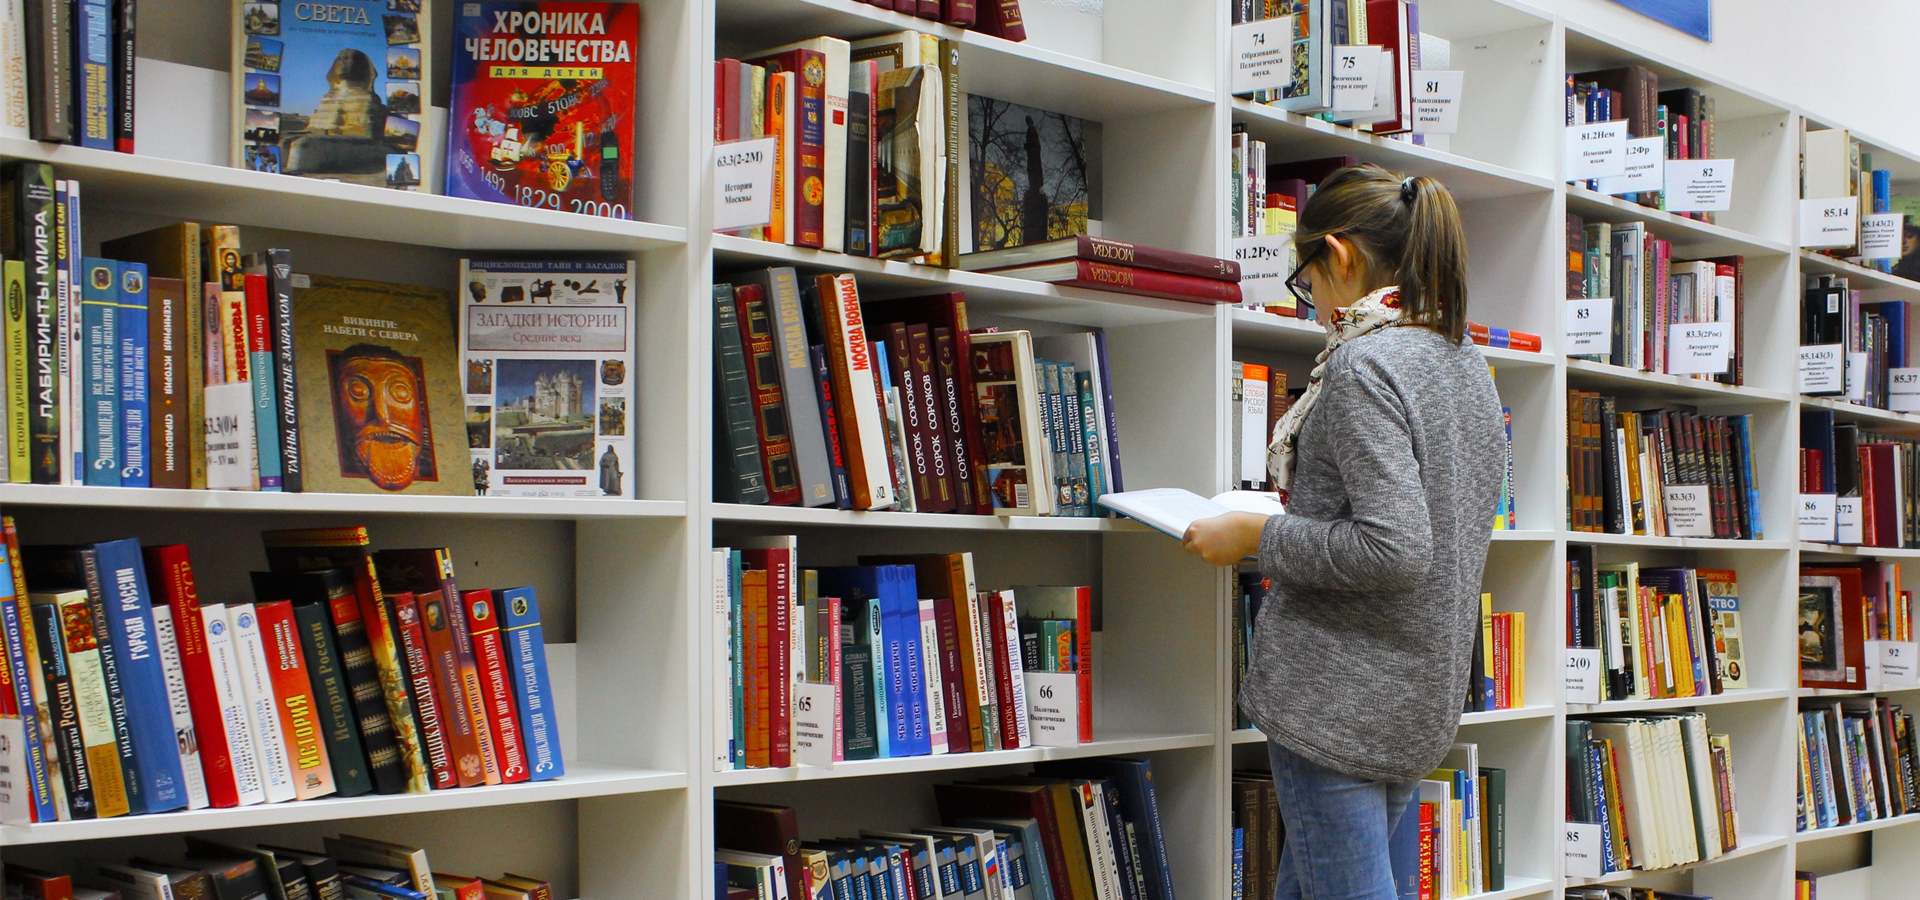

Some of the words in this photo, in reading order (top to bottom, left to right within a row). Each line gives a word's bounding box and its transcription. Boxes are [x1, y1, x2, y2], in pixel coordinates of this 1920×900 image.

[294, 3, 371, 26] СВЕТА
[492, 11, 605, 35] ХРОНИКА
[464, 38, 631, 63] ЧЕЛОВЕЧЕСТВА
[1252, 32, 1265, 46] 74
[544, 69, 598, 77] ДЕТЕЙ
[1342, 56, 1356, 70] 75
[1426, 80, 1439, 93] 81
[1626, 146, 1650, 156] 1.2Фр
[1702, 168, 1714, 178] 82
[515, 184, 560, 214] 1829
[724, 182, 752, 192] История
[724, 194, 752, 204] Москвы
[57, 202, 66, 224] САМ!
[1824, 208, 1849, 218] 85.14
[35, 210, 50, 275] МИРА
[58, 227, 67, 260] СДЕЛАЙ
[1092, 242, 1134, 262] МОСКВА
[1235, 245, 1279, 260] 81.2Рус
[838, 278, 860, 326] ВОЕННАЯ
[1577, 308, 1590, 319] 83
[164, 298, 173, 350] ВСЕМИРНАЯ
[279, 293, 292, 362] ЗАБРАЛОМ
[477, 312, 543, 328] ЗАГАДКИ
[546, 313, 618, 328] ИСТОРИИ
[324, 324, 367, 338] НАБЕГИ
[378, 330, 418, 342] СЕВЕРА
[513, 331, 558, 346] Средние
[560, 334, 582, 344] века
[37, 282, 53, 419] ЛАБИРИНТЫ
[848, 327, 868, 371] МОСКВА
[164, 355, 173, 394] ИСТОРИЯ
[1894, 374, 1918, 384] 85.37
[282, 365, 296, 424] СКРЫТЫЕ
[903, 370, 918, 427] СОРОКОВ
[922, 374, 938, 430] СОРОКОВ
[946, 378, 960, 433] СОРОКОВ
[1084, 406, 1096, 432] МИР
[164, 413, 174, 472] СПРАВОЧНИК
[826, 407, 842, 467] МОСКВА
[1088, 434, 1100, 465] ВЕСЬ
[912, 432, 926, 474] СОРОК
[932, 435, 945, 476] СОРОК
[954, 438, 968, 480] СОРОК
[1805, 502, 1816, 510] 86
[970, 597, 983, 668] Экономическая
[1008, 635, 1020, 672] БИЗНЕС
[1888, 648, 1900, 657] 92
[798, 696, 812, 712] 65
[1039, 685, 1053, 699] 66
[414, 676, 448, 770] ЭНЦИКЛОПЕДИЯ
[1012, 683, 1027, 740] ЭКОНОМИКА
[1566, 832, 1579, 842] 85
[1601, 805, 1614, 867] ИСКУССТВО
